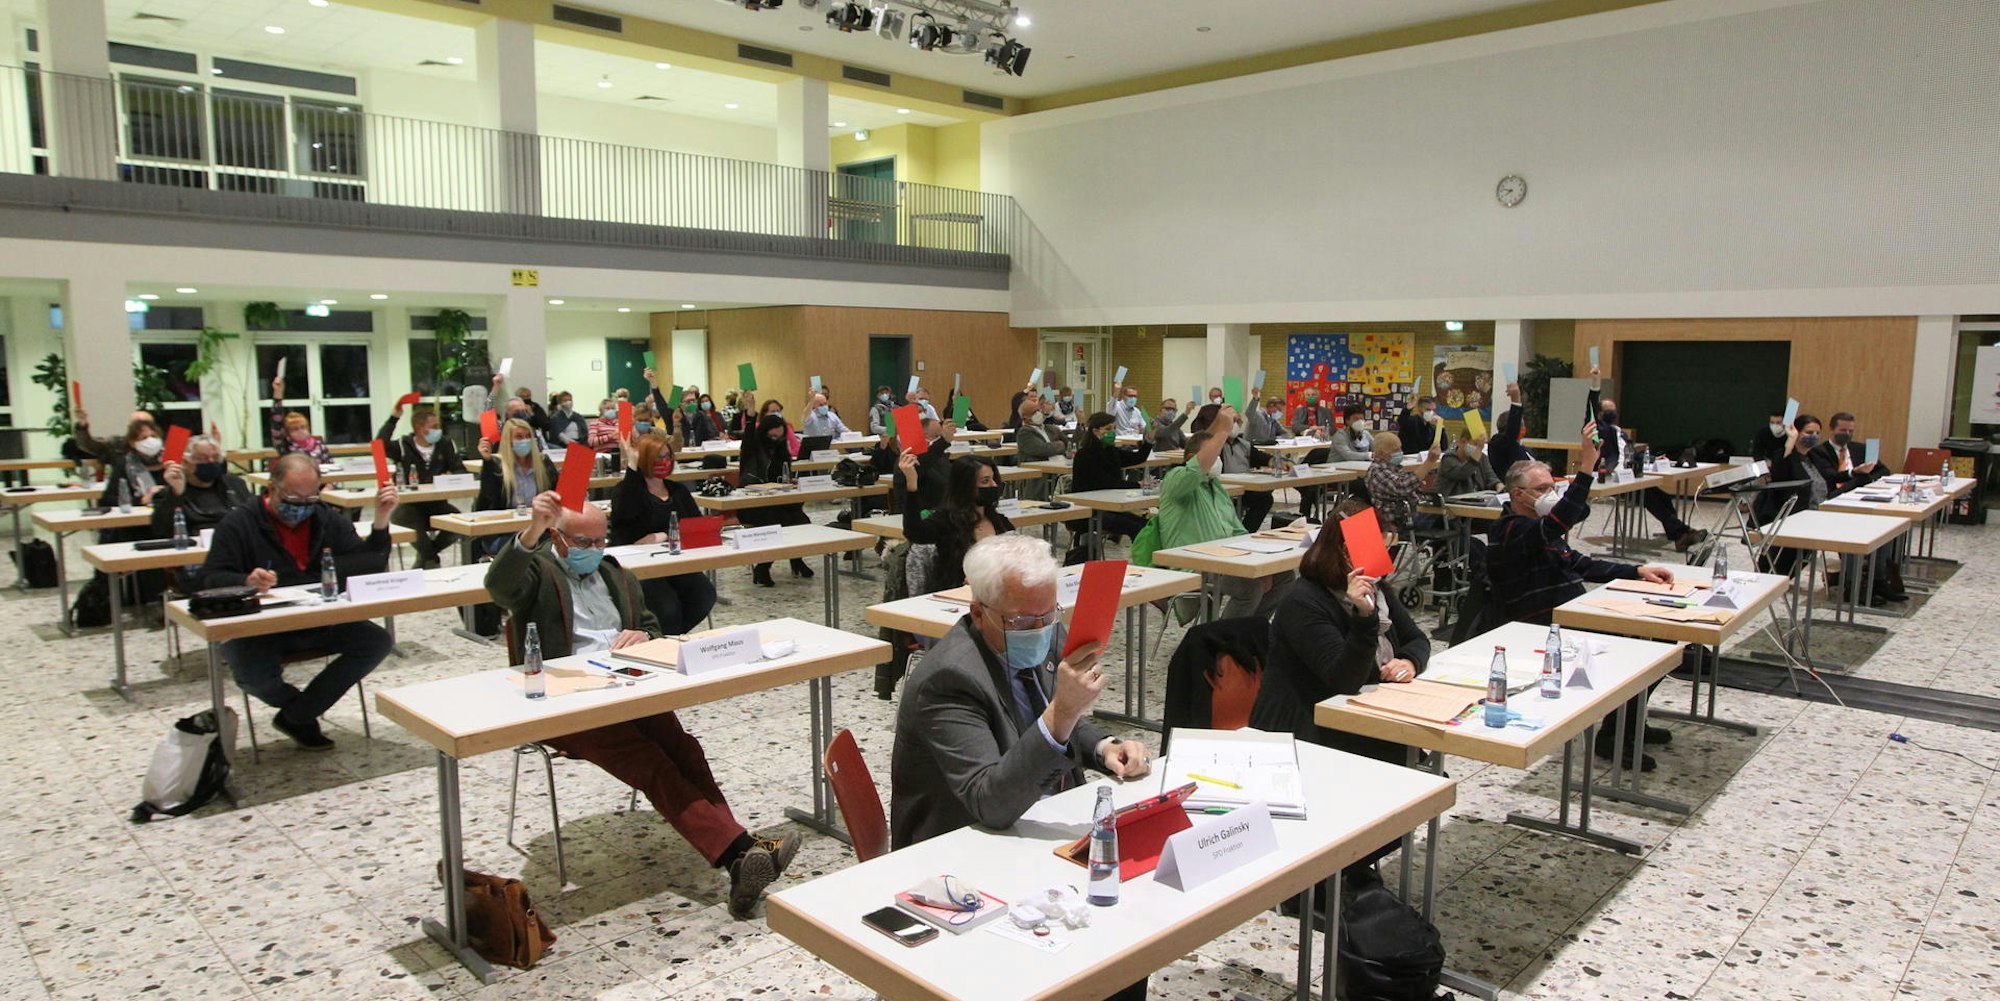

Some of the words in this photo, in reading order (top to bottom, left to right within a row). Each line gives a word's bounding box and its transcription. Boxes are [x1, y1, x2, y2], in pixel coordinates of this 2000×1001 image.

[699, 642, 728, 654] Wolfgang
[727, 640, 744, 648] Maus
[1198, 833, 1221, 850] Ulrich
[1220, 820, 1250, 841] Galinsky
[1212, 849, 1224, 860] SPD
[1223, 841, 1244, 855] Fraktion
